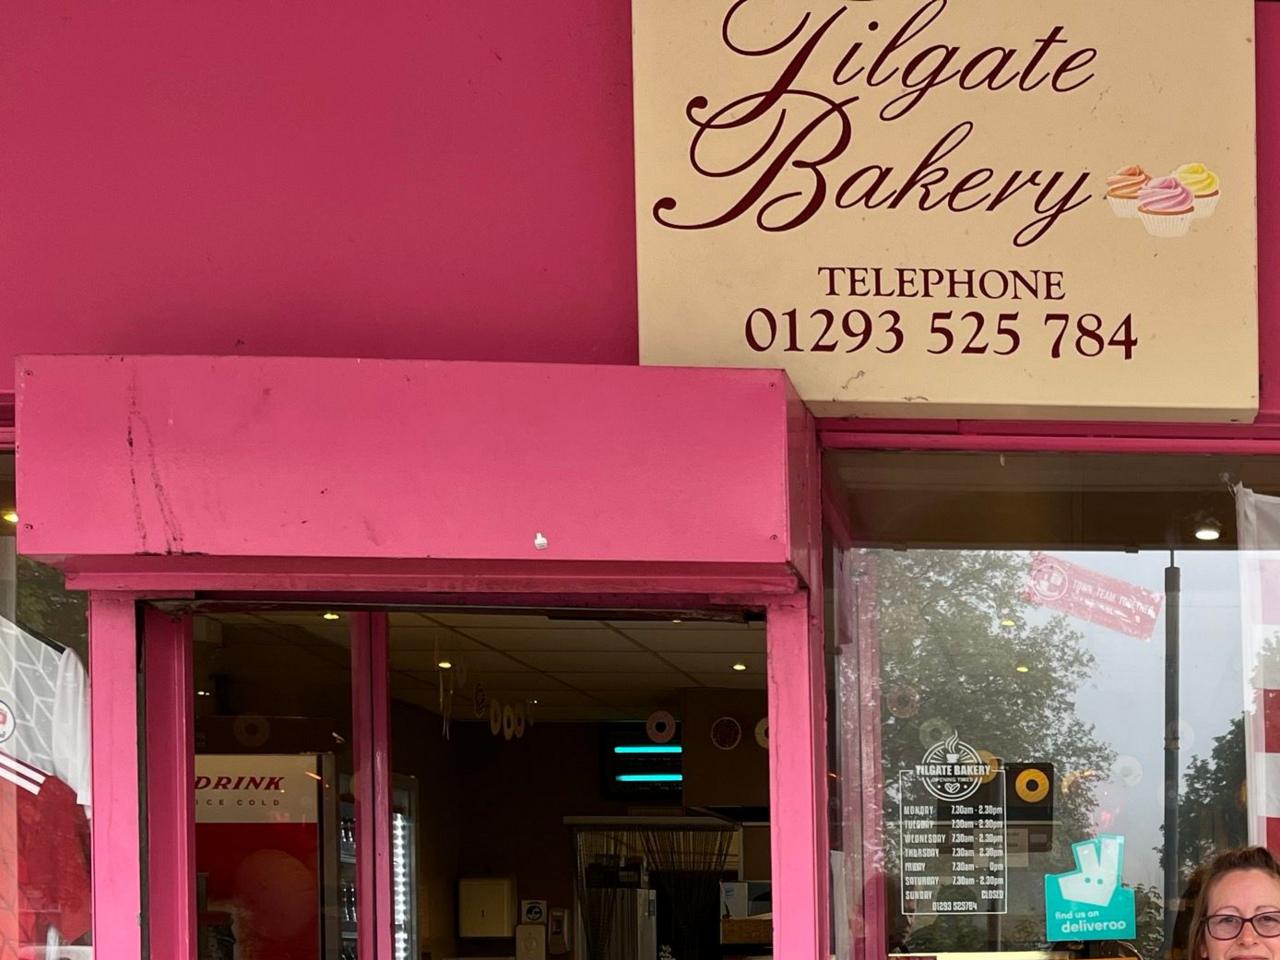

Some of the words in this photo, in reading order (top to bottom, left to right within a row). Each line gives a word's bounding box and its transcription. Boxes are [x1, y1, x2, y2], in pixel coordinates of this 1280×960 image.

[686, 0, 1098, 129] Tilgate
[653, 89, 1094, 247] Bakery
[818, 267, 1066, 300] TELEPHONE
[744, 308, 905, 355] 01293
[928, 312, 1021, 355] 525
[1044, 312, 1138, 360] 784
[194, 776, 285, 790] DRINK
[915, 765, 952, 775] TILGATE
[954, 765, 991, 775] BAKERY
[1061, 920, 1126, 933] deliveroo
